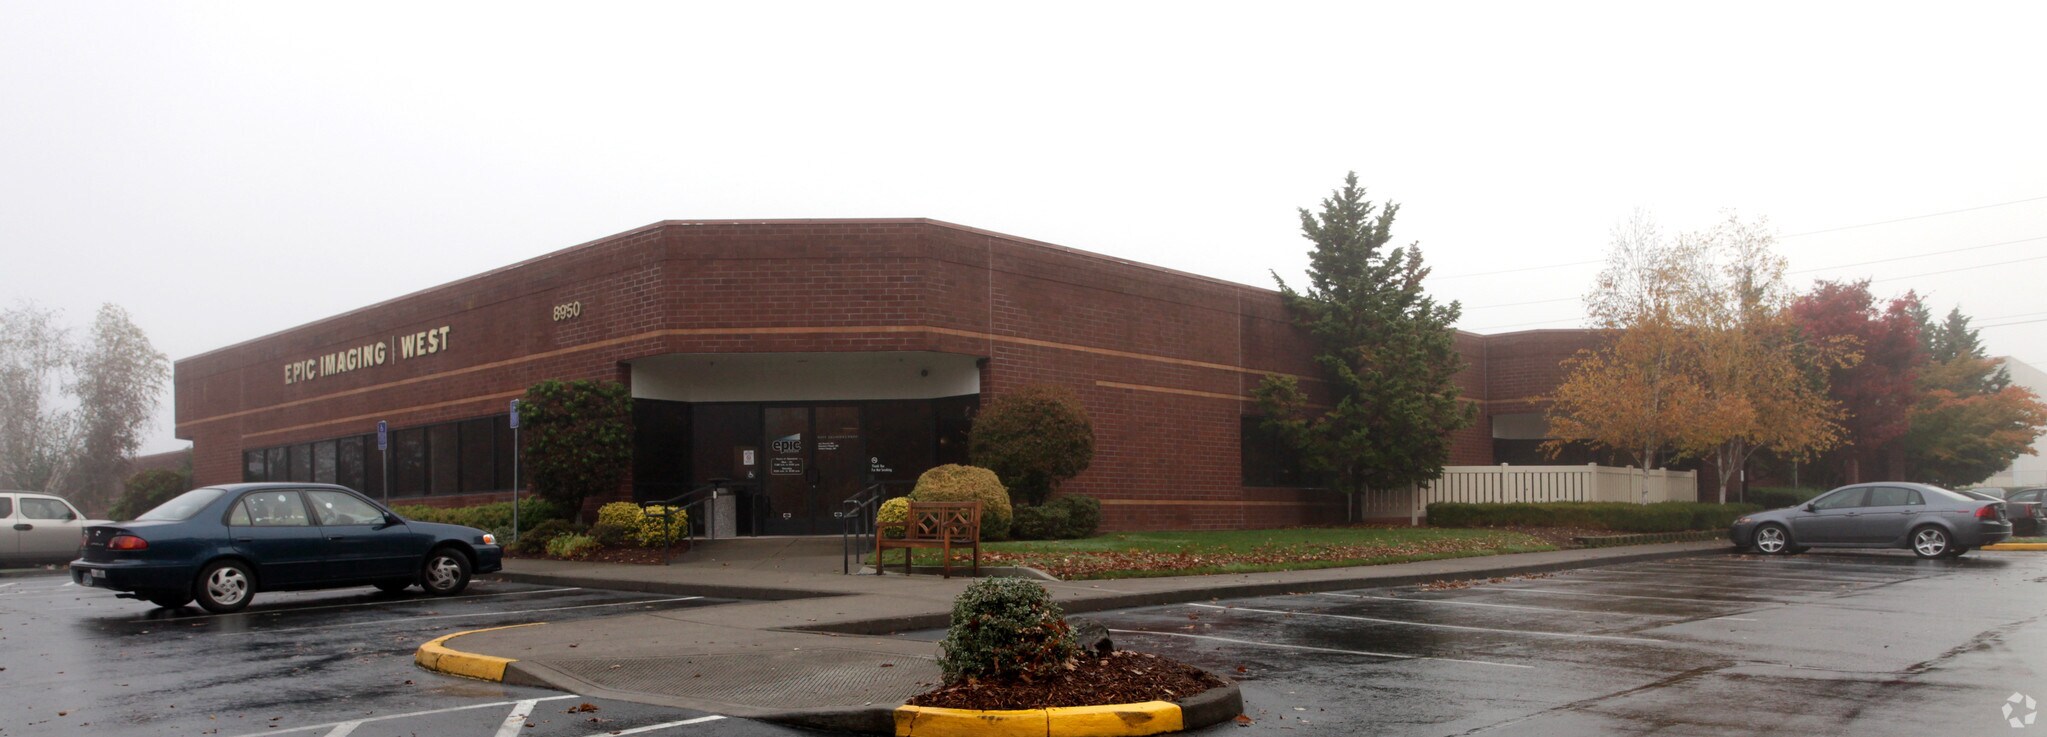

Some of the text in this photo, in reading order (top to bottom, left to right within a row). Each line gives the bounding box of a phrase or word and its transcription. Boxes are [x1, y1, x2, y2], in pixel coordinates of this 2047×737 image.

[553, 301, 580, 321] 8950
[284, 325, 450, 385] EPIC IMAGING WEST
[772, 440, 802, 454] epic
